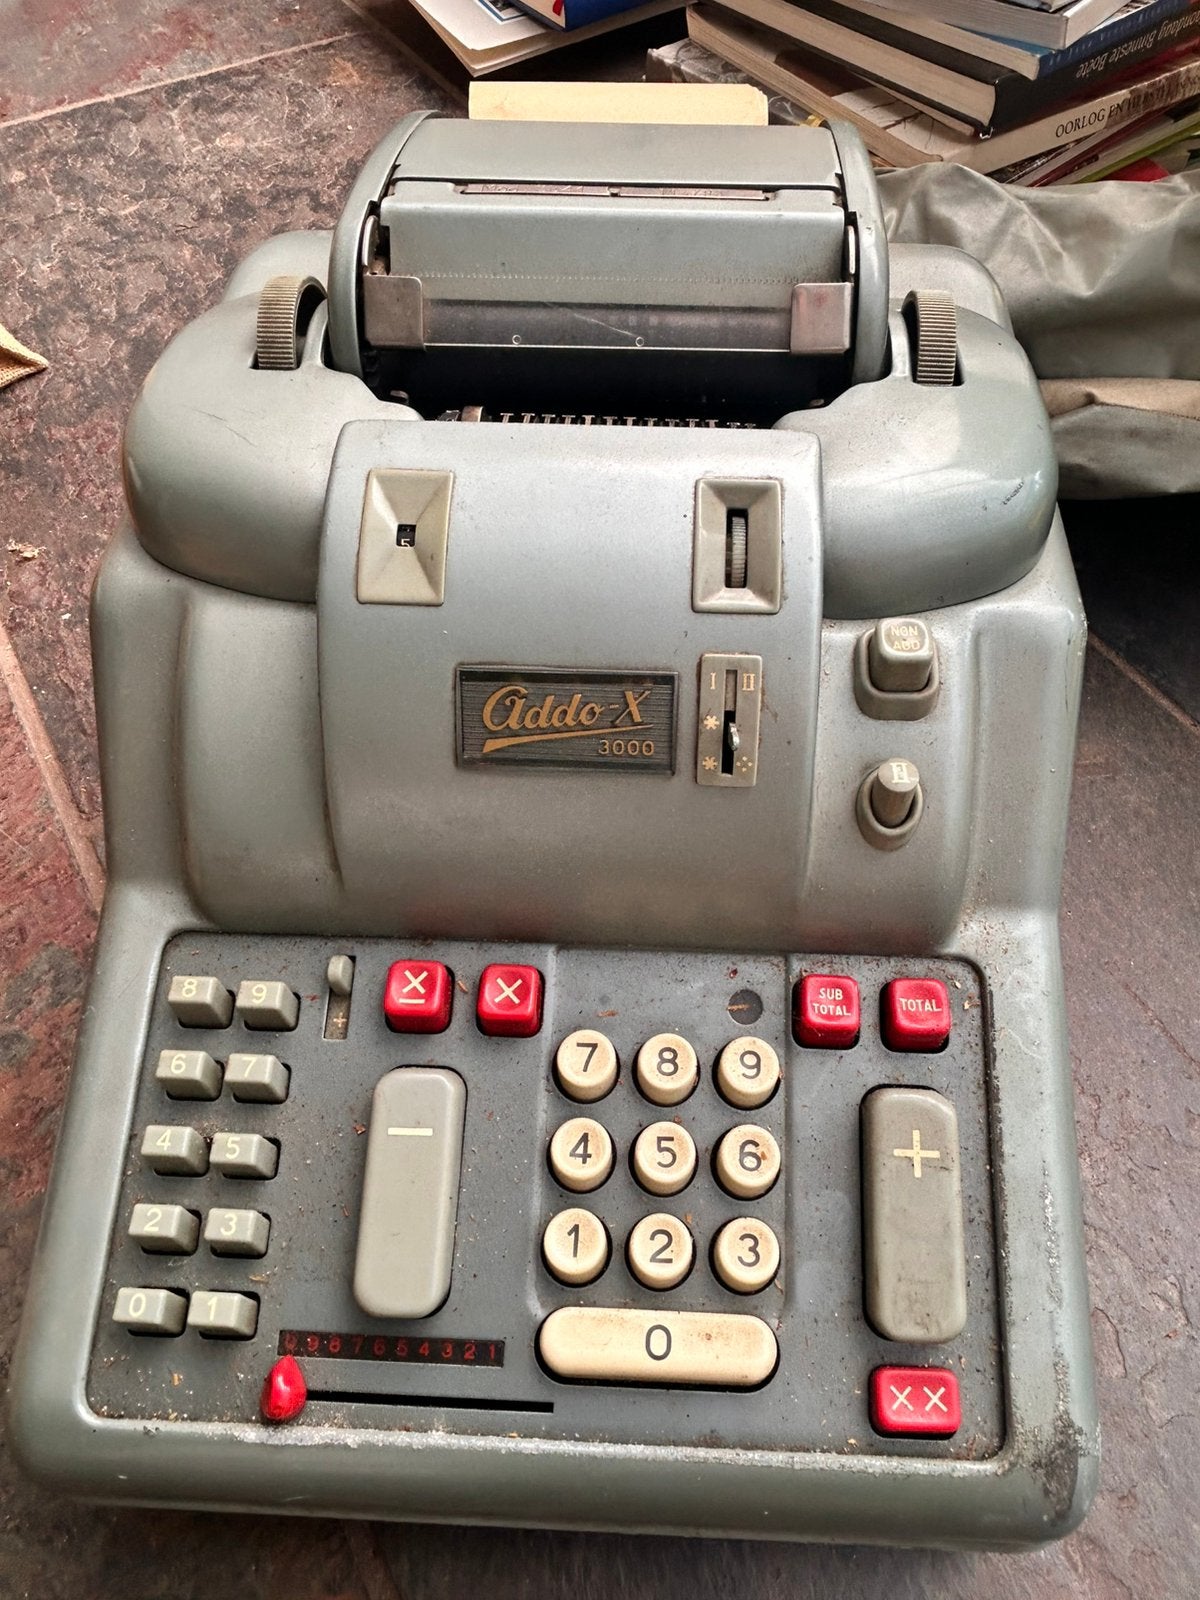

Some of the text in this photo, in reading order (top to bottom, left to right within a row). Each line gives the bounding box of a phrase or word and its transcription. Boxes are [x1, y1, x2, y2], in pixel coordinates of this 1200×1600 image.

[1055, 101, 1124, 138] OORLOG EN
[891, 626, 918, 637] NON
[598, 739, 655, 756] 3000
[181, 977, 198, 998] 8
[252, 983, 268, 1004] 9
[818, 987, 843, 1000] SUB
[812, 1003, 851, 1016] TOTAL
[899, 997, 942, 1012] TOTAL
[171, 1053, 186, 1074] 6
[242, 1056, 257, 1077] 7
[575, 1042, 599, 1073] 7
[656, 1046, 679, 1076] 8
[739, 1050, 762, 1080] 9
[156, 1128, 172, 1151] 4
[225, 1136, 241, 1160] 5
[569, 1132, 592, 1165] 4
[656, 1136, 678, 1168] 5
[739, 1139, 762, 1172] 6
[143, 1207, 162, 1232] 2
[220, 1213, 238, 1236] 3
[567, 1223, 580, 1258] 1
[650, 1228, 674, 1264] 2
[737, 1233, 761, 1267] 3
[128, 1292, 146, 1317] 0
[207, 1296, 218, 1321] 1
[328, 1336, 341, 1353] 8
[418, 1341, 429, 1357] 4
[441, 1342, 453, 1358] 3
[463, 1343, 475, 1360] 2
[489, 1343, 496, 1360] 1
[645, 1324, 672, 1361] 0
